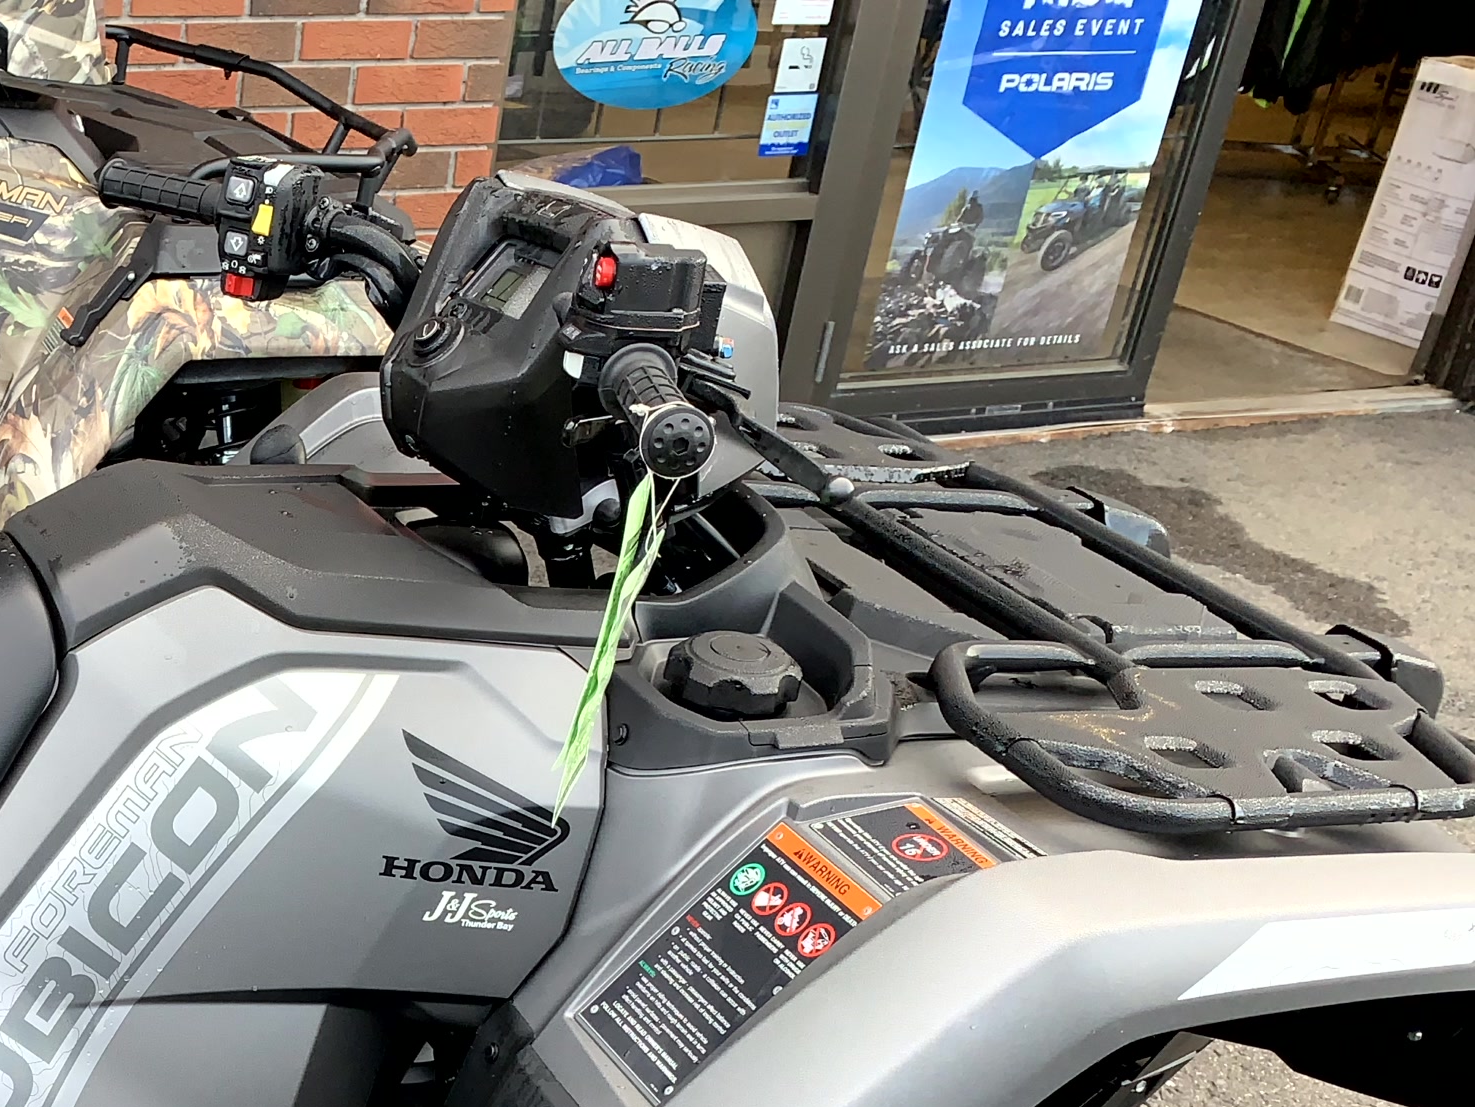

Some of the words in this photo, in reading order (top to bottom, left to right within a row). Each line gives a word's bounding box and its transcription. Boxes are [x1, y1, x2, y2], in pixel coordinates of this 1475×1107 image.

[998, 19, 1067, 37] SALES
[1074, 18, 1145, 36] EVENT
[576, 39, 633, 64] ALL
[633, 33, 726, 61] BALLS
[575, 65, 608, 75] Bearings
[617, 63, 662, 72] Components
[662, 56, 726, 85] Racing
[998, 72, 1115, 93] POLARIS
[888, 344, 908, 354] ASK
[912, 343, 919, 353] A
[923, 341, 955, 352] SALES
[958, 338, 1013, 350] ASSOCIATE
[1017, 336, 1036, 347] FOR
[1039, 334, 1081, 345] DETAILS
[3, 724, 204, 975] FOREMAN
[896, 842, 924, 856] 16
[910, 835, 944, 856] UNDER
[933, 826, 991, 863] WARNING
[379, 855, 559, 892] HONDA
[774, 856, 786, 866] ATV
[800, 852, 851, 896] WARNING
[422, 890, 479, 924] J&J
[468, 900, 518, 922] Sports
[460, 918, 495, 930] Thunder
[497, 921, 515, 932] Bay
[611, 999, 630, 1017] LOCATE
[626, 1014, 637, 1026] AND
[599, 1000, 618, 1019] FOLLOW
[613, 1015, 625, 1026] ALL
[646, 1050, 658, 1062] AND
